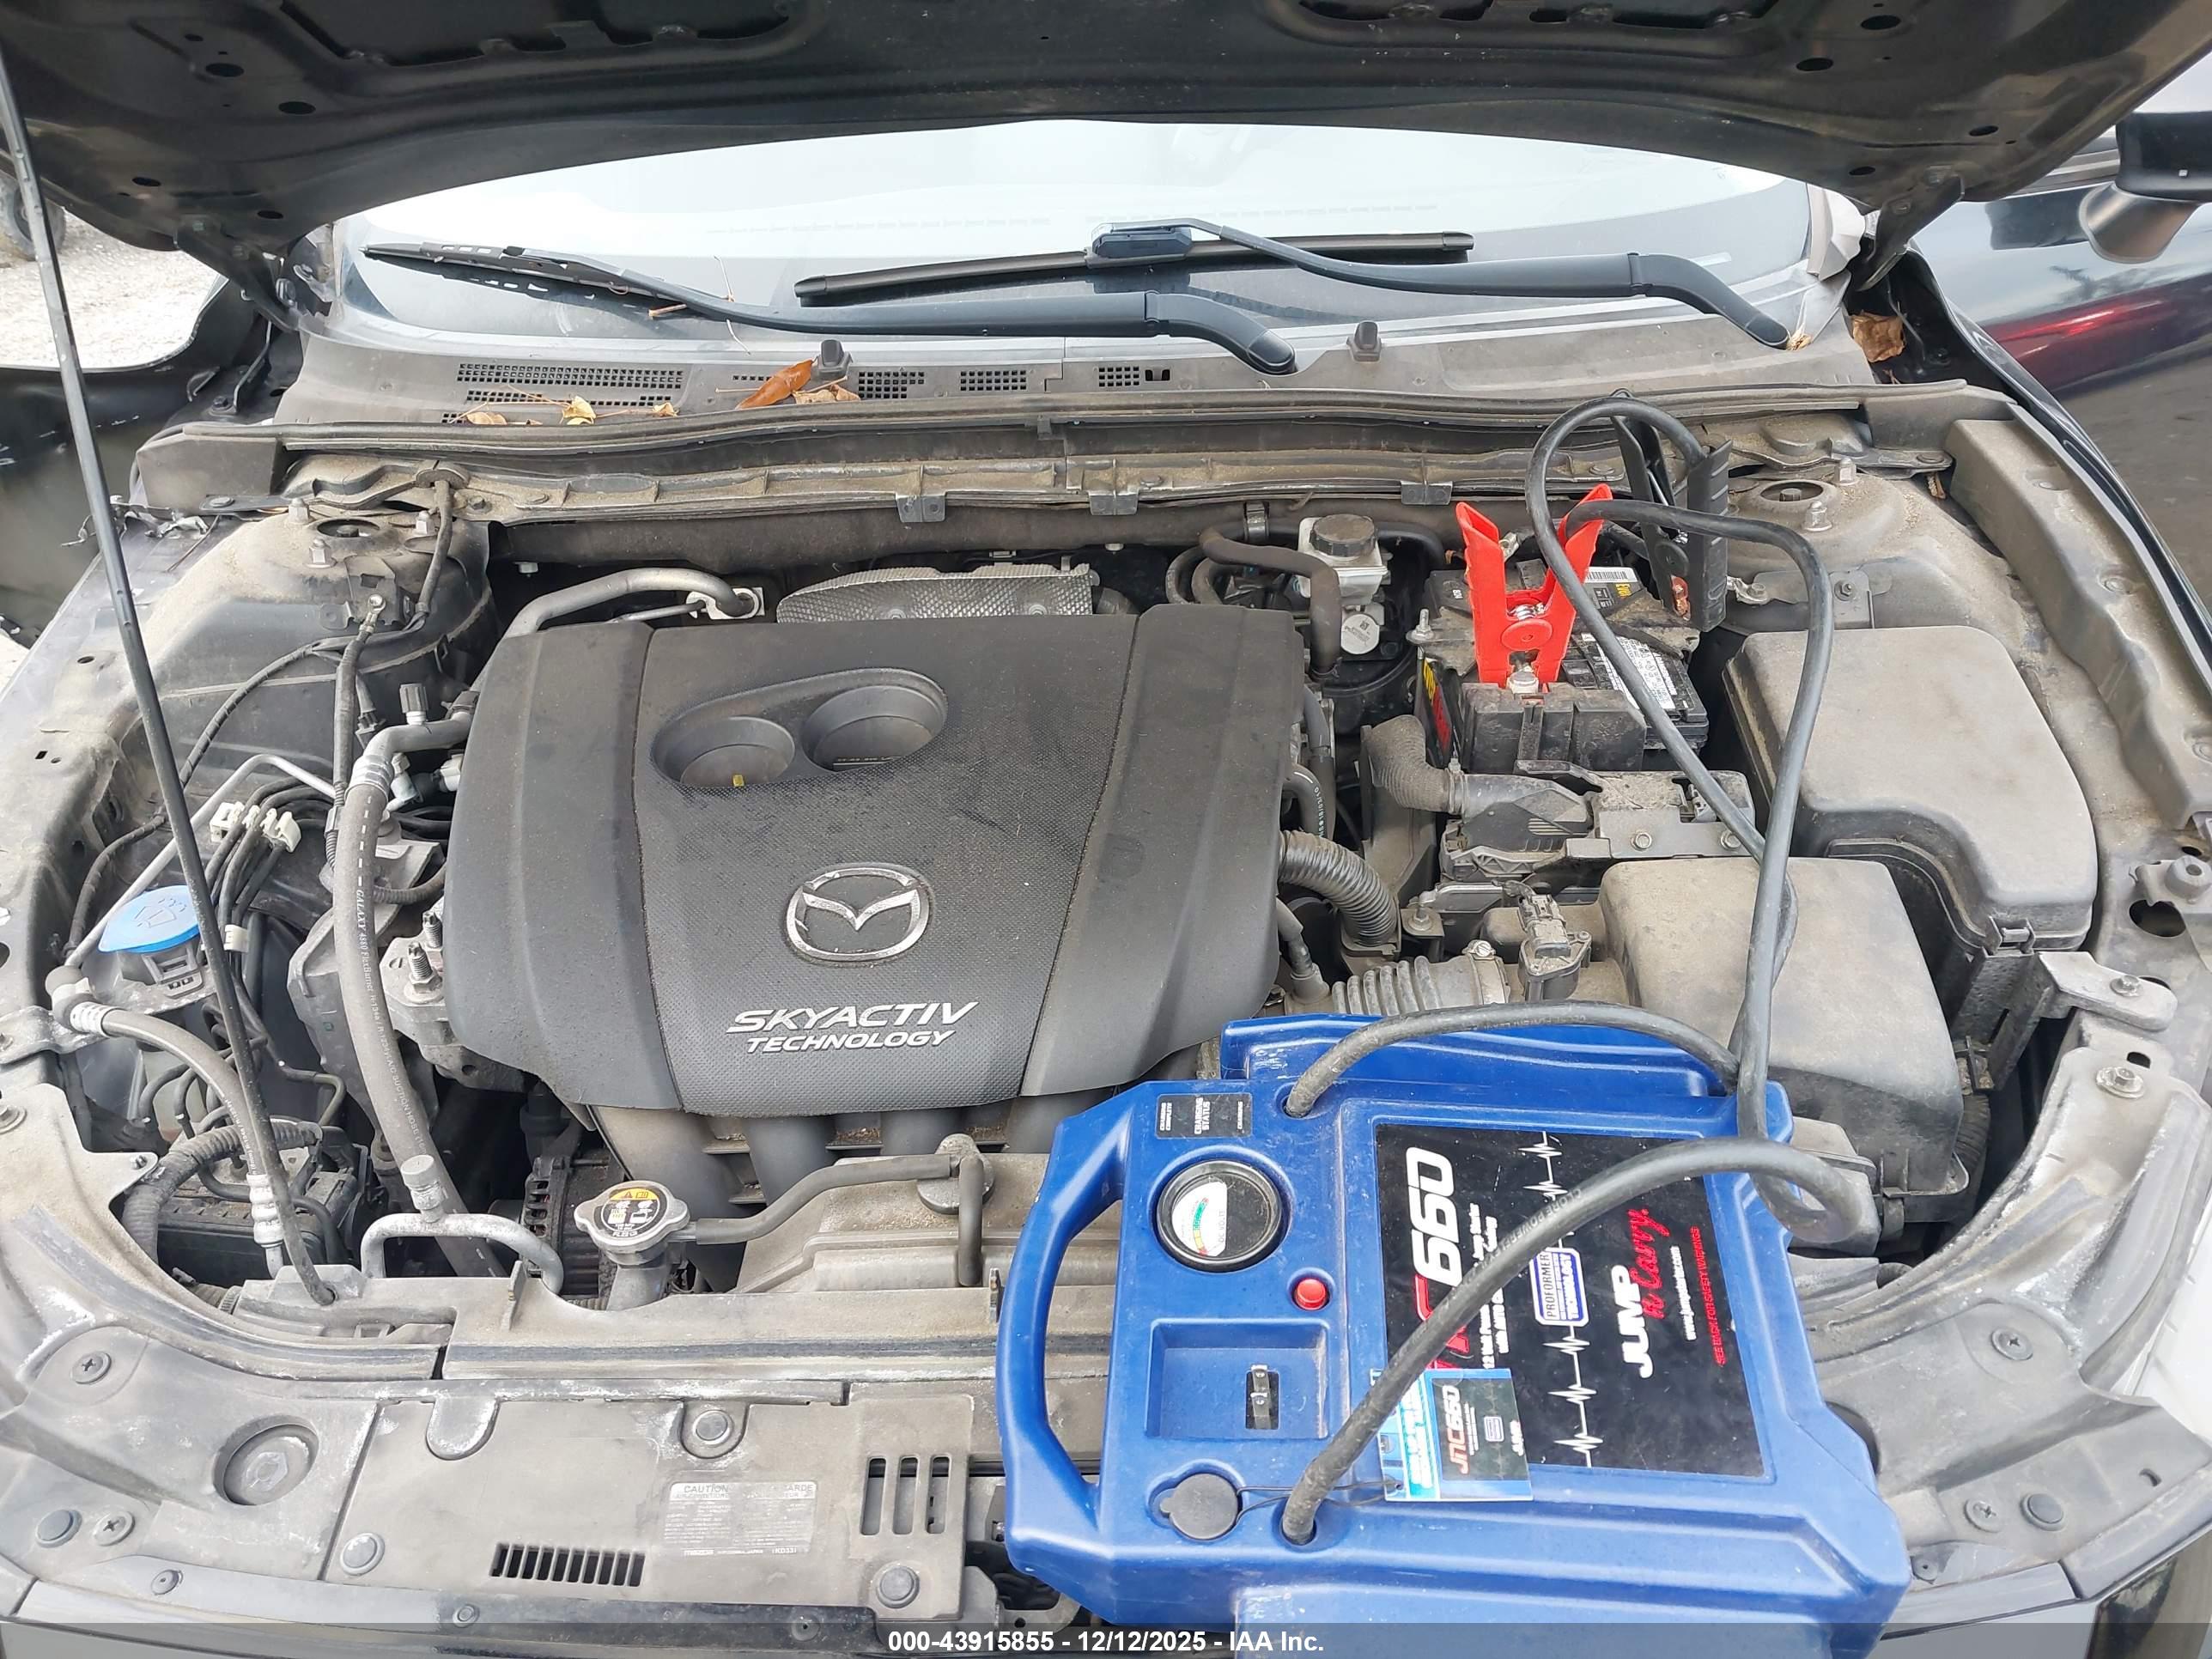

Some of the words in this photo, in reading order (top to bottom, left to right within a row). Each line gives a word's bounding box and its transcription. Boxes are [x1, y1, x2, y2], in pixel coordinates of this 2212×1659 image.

[356, 890, 367, 930] GALAXY
[392, 1075, 411, 1111] SUCTION
[405, 1111, 419, 1135] HOSE
[726, 1001, 980, 1034] SKYACTIV
[746, 1030, 957, 1054] TECHNOLOGY
[1194, 1097, 1203, 1134] CHARGING
[1690, 1226, 1706, 1269] WARNINGS
[1540, 1255, 1557, 1317] PROFORMER
[1559, 1254, 1579, 1319] TECHNOLOGY
[1699, 1270, 1713, 1302] SAFETY
[1611, 1266, 1654, 1378] JUMP
[1483, 1356, 1494, 1369] 12
[1443, 1385, 1468, 1474] JNC660
[684, 1483, 729, 1493] CAUTION
